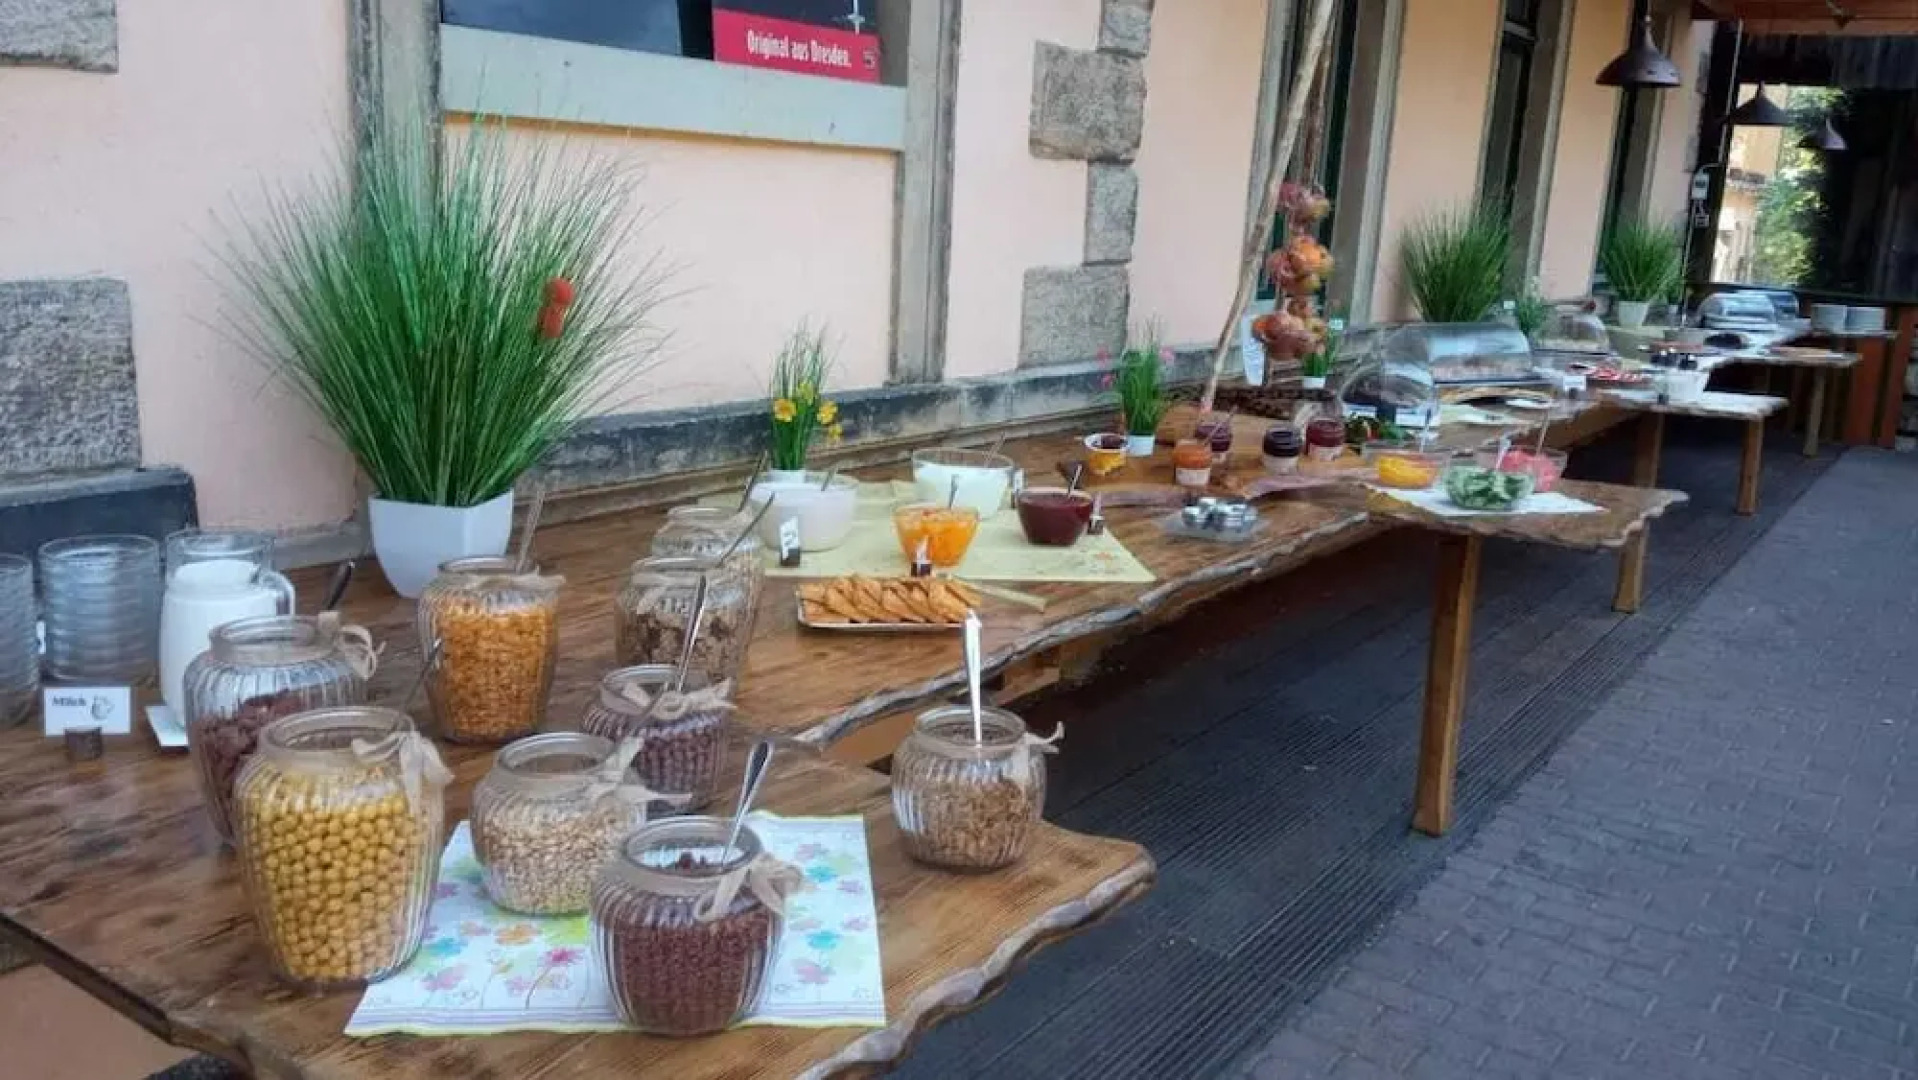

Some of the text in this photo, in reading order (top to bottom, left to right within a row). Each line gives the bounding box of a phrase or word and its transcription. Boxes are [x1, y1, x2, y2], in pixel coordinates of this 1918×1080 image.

[747, 29, 852, 68] Original aus Dresden.
